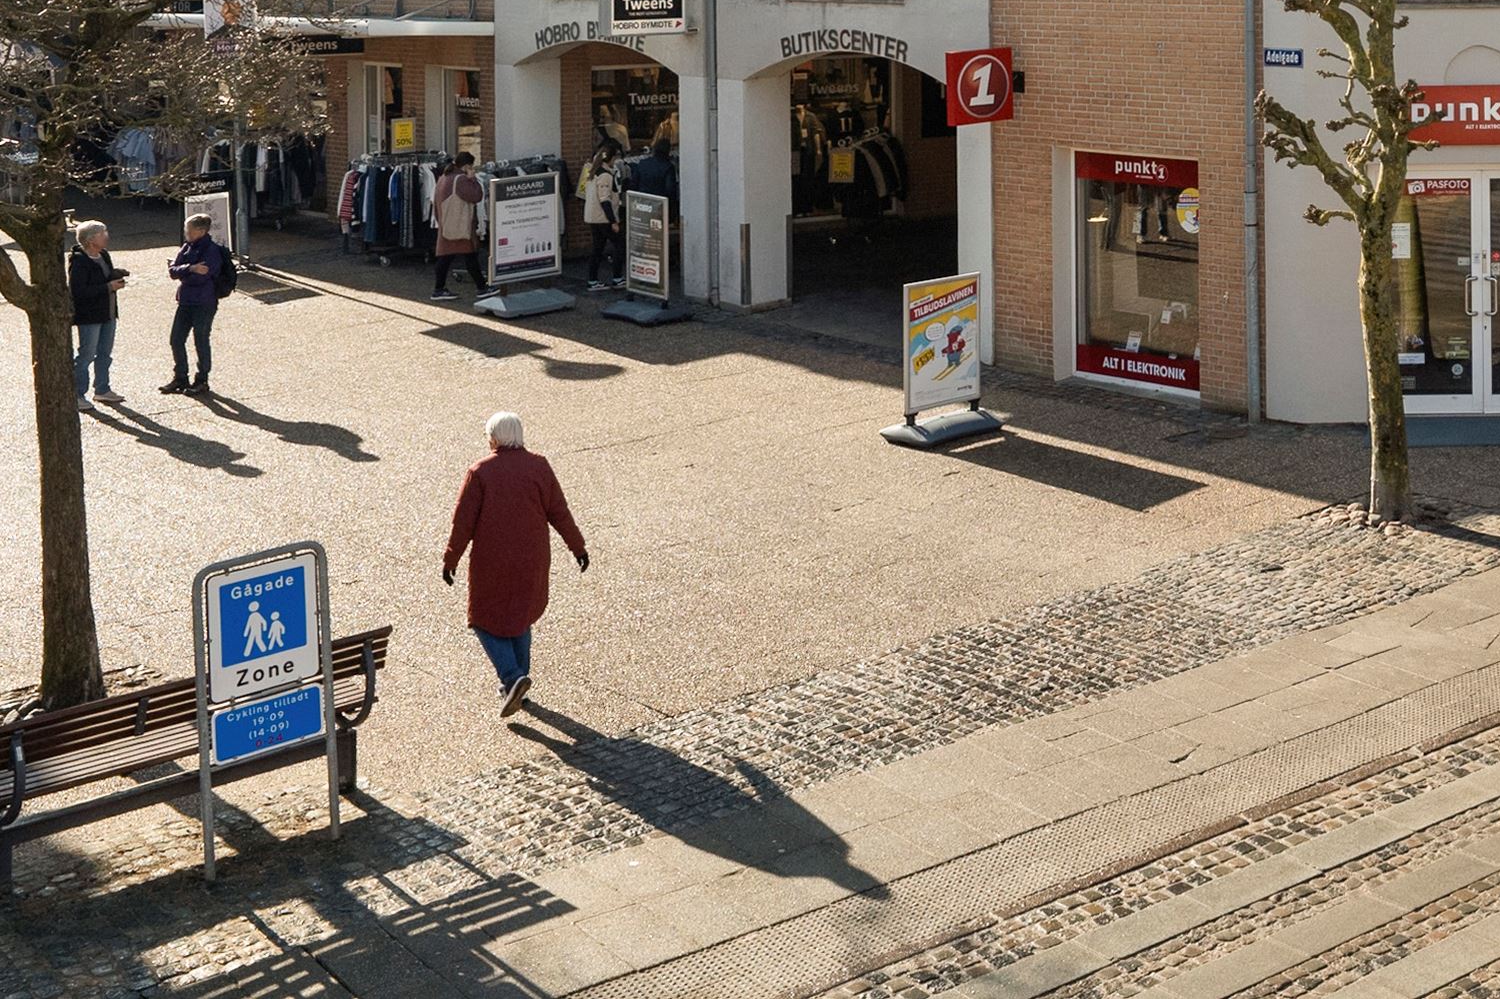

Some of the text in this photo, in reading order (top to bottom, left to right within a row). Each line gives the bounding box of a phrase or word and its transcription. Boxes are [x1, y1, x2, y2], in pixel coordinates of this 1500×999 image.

[535, 22, 580, 50] HOBRO
[612, 22, 640, 30] HOBRO
[780, 29, 908, 62] BUTIKSCENTER
[1266, 50, 1299, 64] Adelgade
[809, 83, 858, 95] Tweens
[969, 62, 995, 106] 1
[456, 94, 480, 108] Tween
[628, 93, 679, 106] Tween
[396, 138, 412, 146] 50%
[506, 180, 544, 192] MAAGAARD
[1427, 180, 1468, 189] PASFOTO
[914, 286, 974, 318] TILBUDSLAVINEN
[1103, 356, 1186, 380] ALT I ELEKTRONIK
[231, 576, 294, 600] Gågade
[236, 660, 294, 687] Zone
[226, 692, 309, 722] Cykling tilladt
[248, 720, 290, 740] (14-09)
